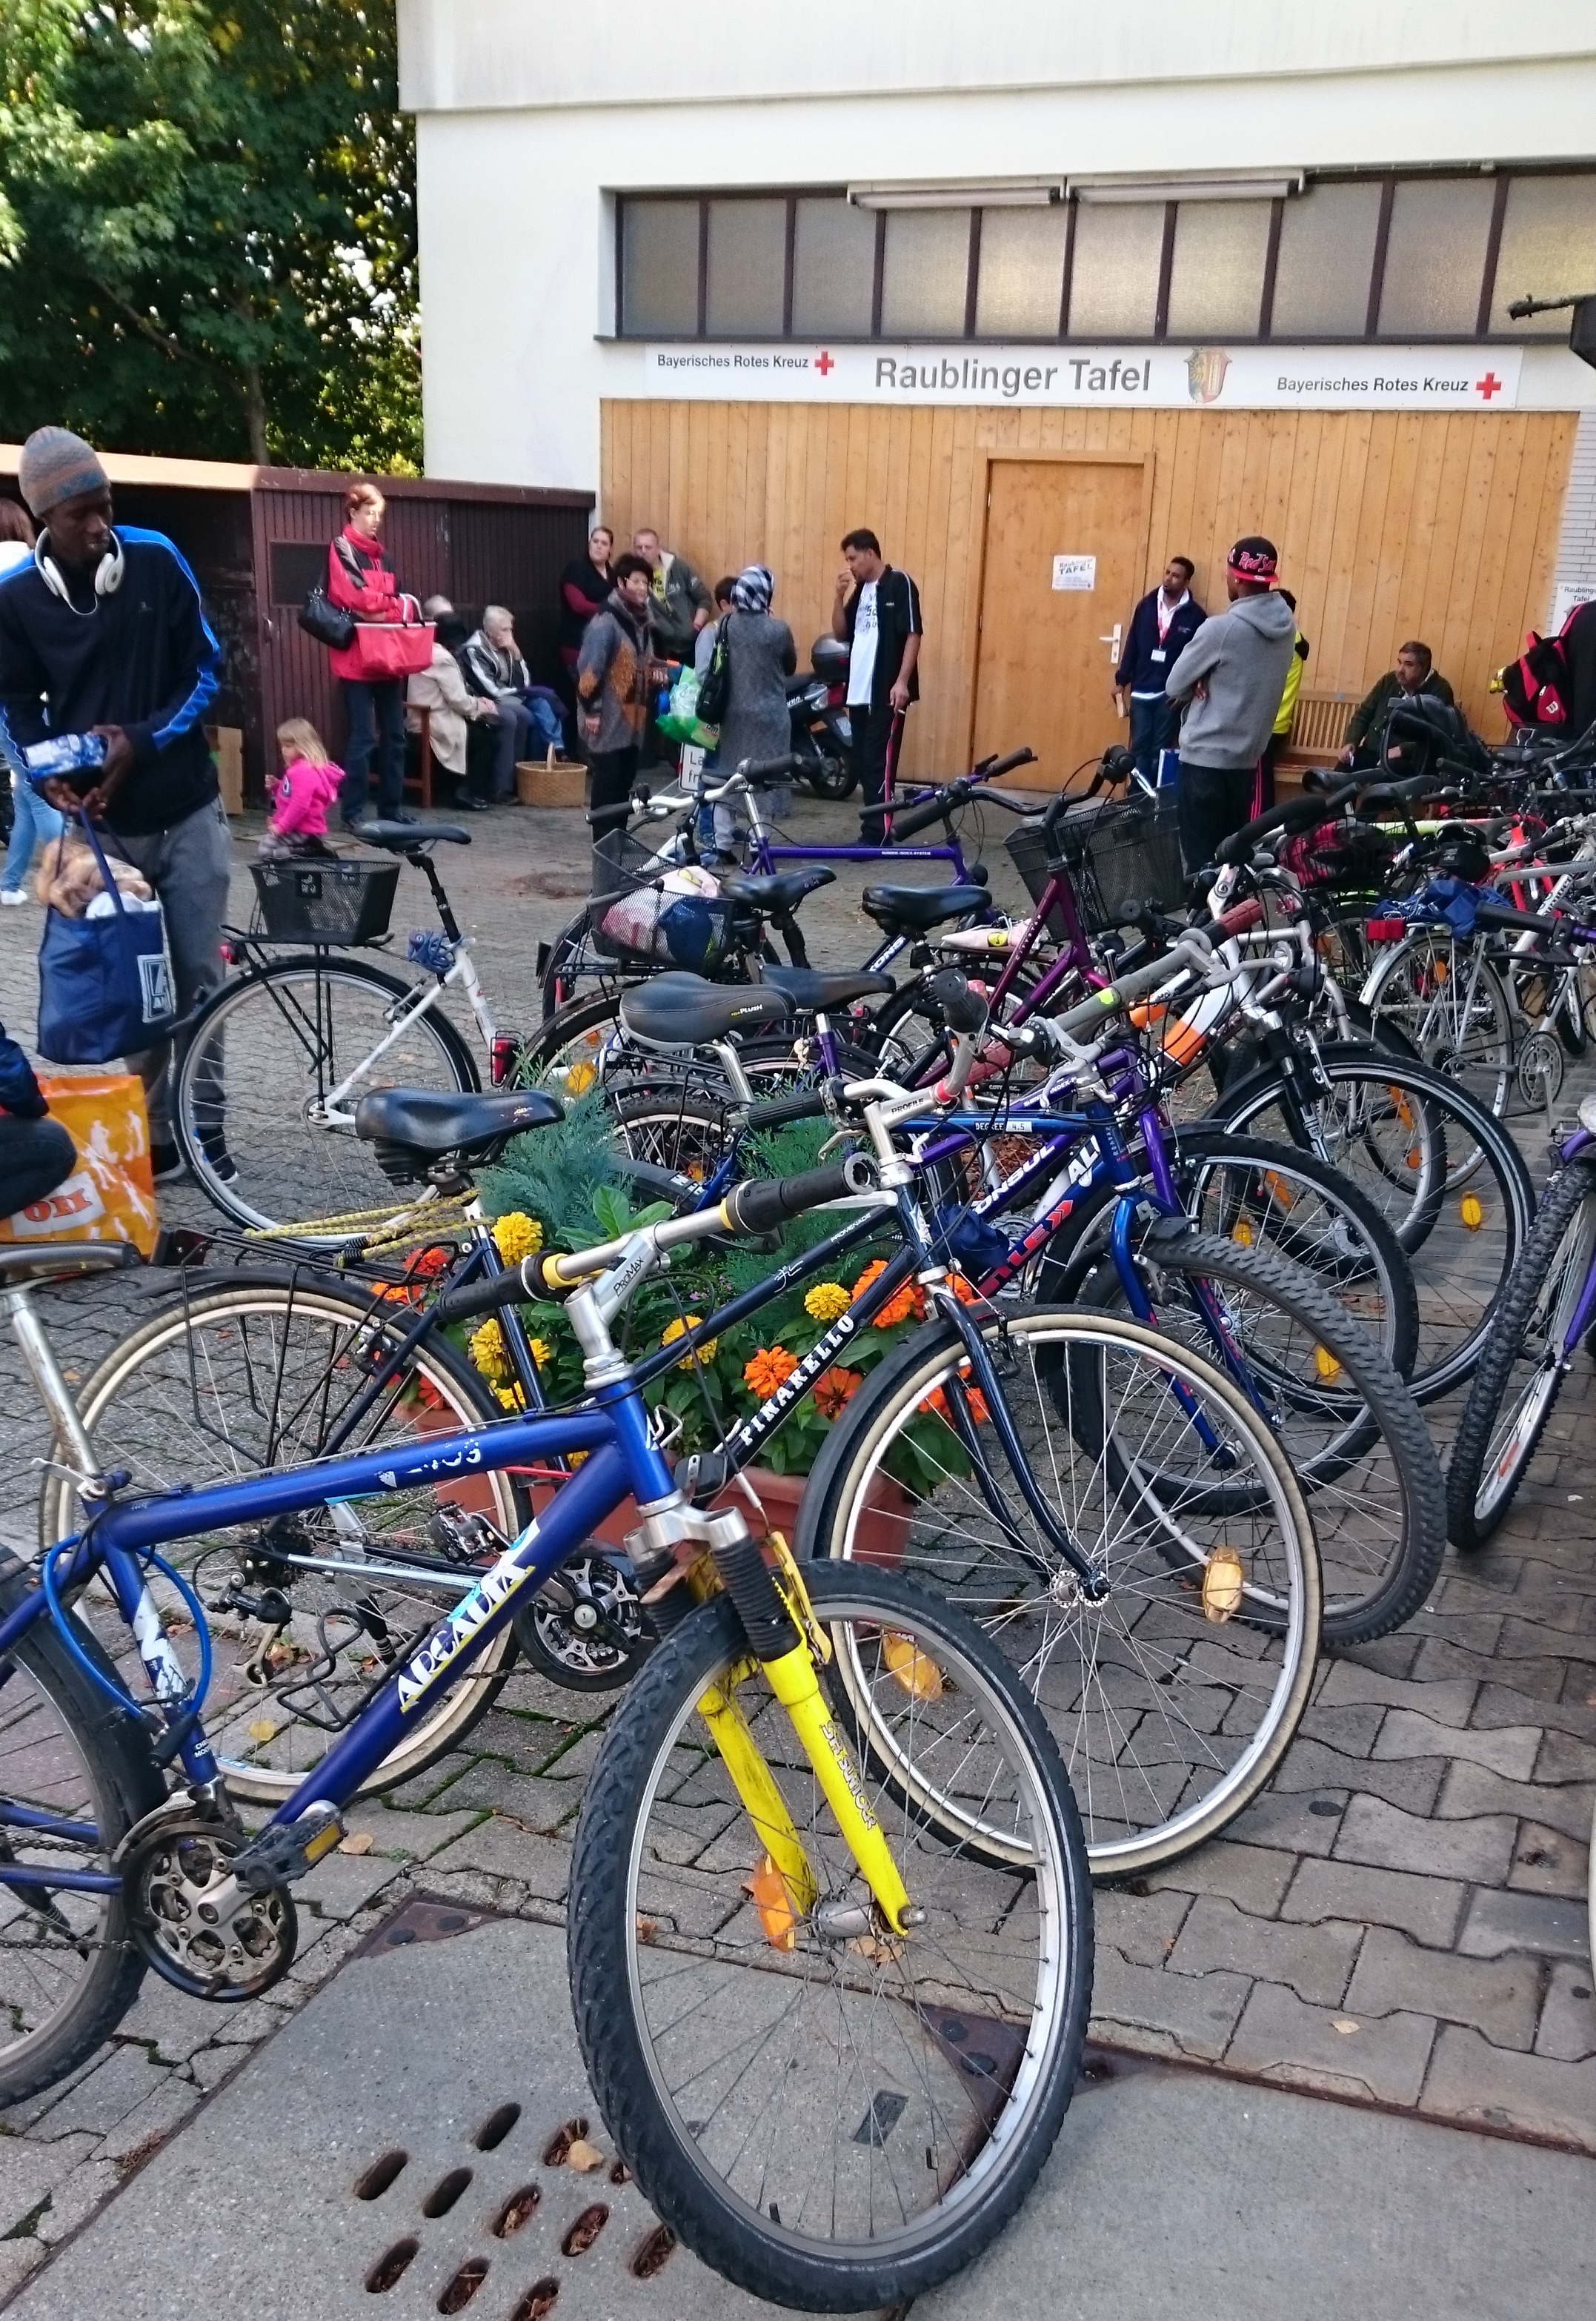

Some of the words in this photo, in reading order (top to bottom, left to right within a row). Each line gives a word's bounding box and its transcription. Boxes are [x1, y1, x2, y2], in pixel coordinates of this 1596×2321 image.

[656, 354, 730, 369] Bayerisches
[734, 355, 769, 368] Rotes
[773, 355, 808, 368] Kreuz
[875, 357, 1058, 397] Raublinger
[1068, 359, 1151, 391] Tafel
[1277, 376, 1369, 393] Bayerisches
[1373, 377, 1418, 391] Rotes
[1423, 377, 1469, 391] Kreuz
[1058, 563, 1093, 575] TAFEL
[689, 751, 704, 766] La
[688, 770, 699, 783] fr
[739, 1003, 763, 1015] PLUSH
[891, 1098, 924, 1115] PROFILE
[1011, 1123, 1025, 1131] 4.5
[972, 1145, 1056, 1215] ONSUL
[830, 1212, 871, 1243] PROMENADE
[614, 1256, 644, 1297] PROMAX
[738, 1314, 854, 1446] PINARELLO
[397, 1564, 528, 1707] ARCADIA
[837, 1754, 878, 1831] SUNTOUR
